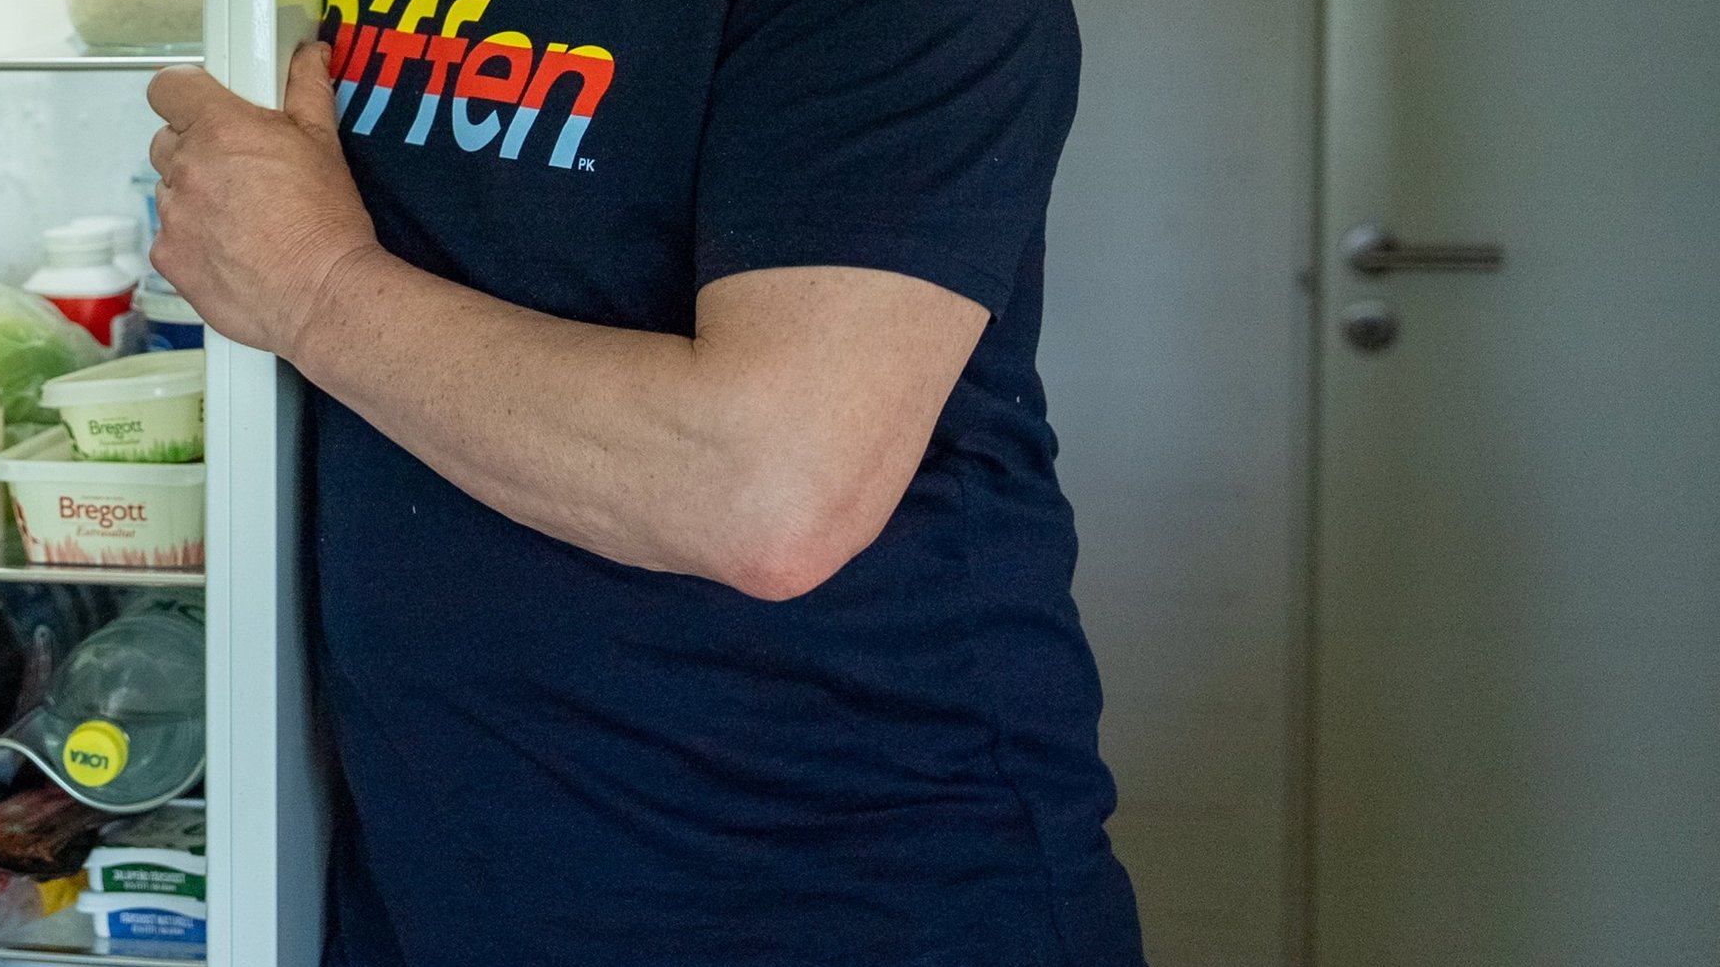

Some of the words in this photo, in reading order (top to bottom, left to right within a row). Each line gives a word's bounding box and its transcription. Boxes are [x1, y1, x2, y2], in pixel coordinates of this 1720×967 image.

[578, 158, 595, 172] PK
[88, 419, 144, 439] Bregott
[59, 495, 148, 529] Bregott
[70, 749, 109, 770] LOKA
